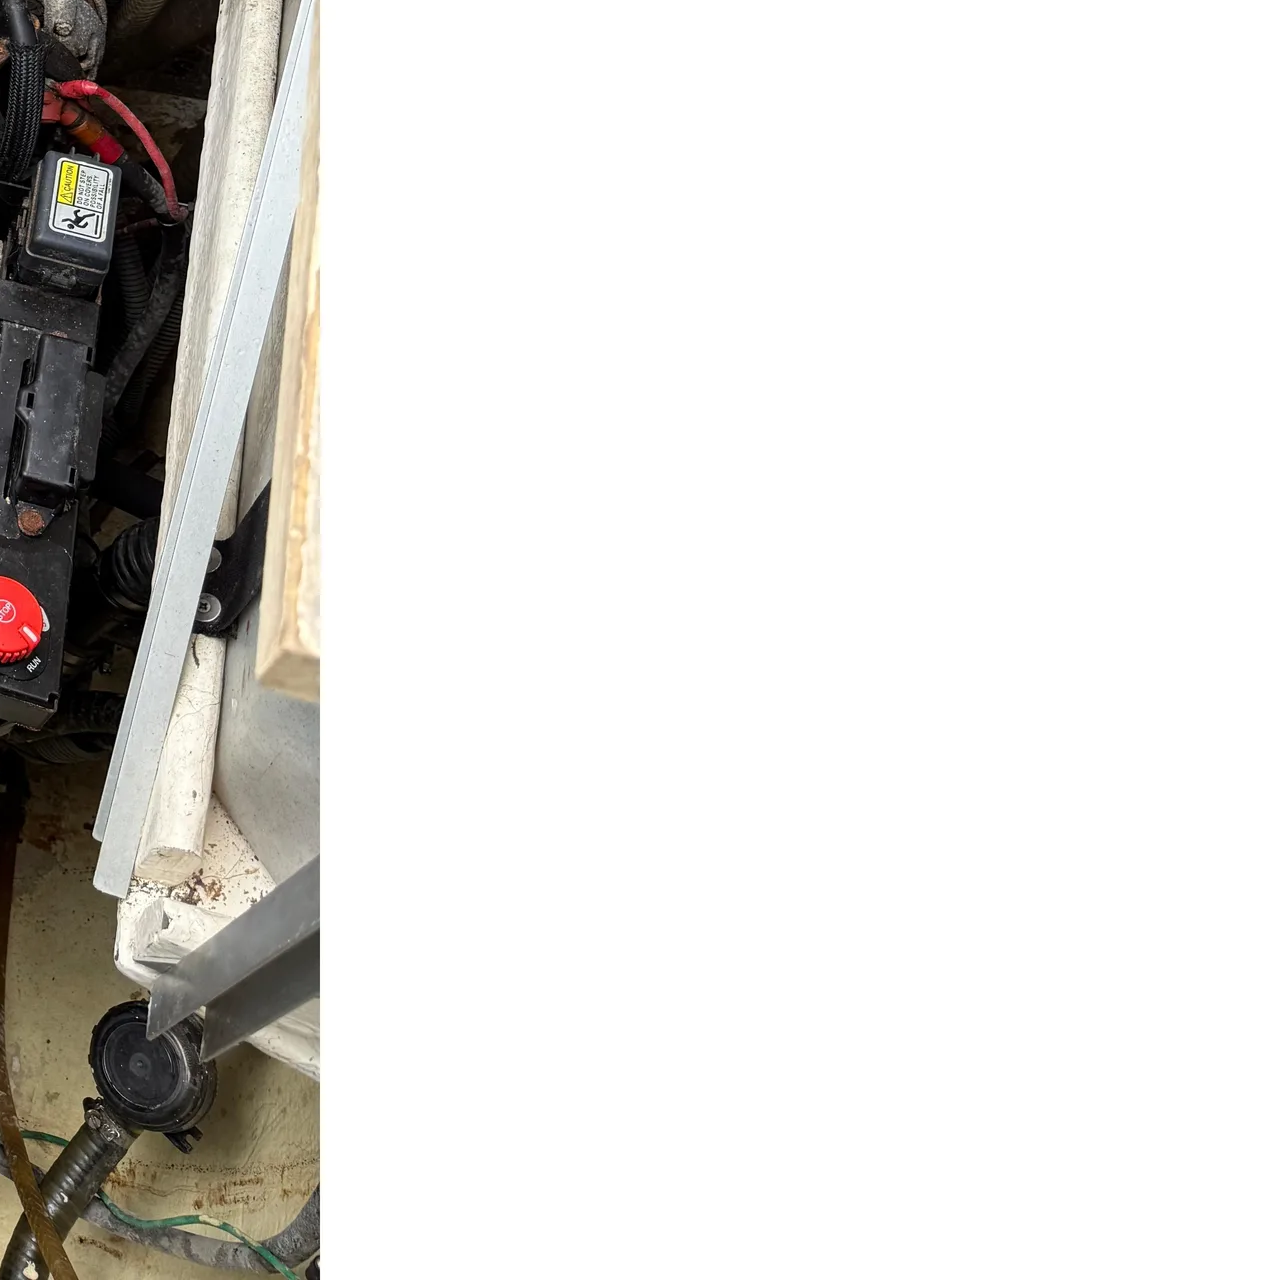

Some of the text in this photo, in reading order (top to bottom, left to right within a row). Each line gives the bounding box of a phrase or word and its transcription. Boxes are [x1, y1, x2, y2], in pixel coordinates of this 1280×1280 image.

[64, 165, 74, 191] CAUTION
[77, 196, 83, 205] DO
[83, 198, 90, 206] ON
[96, 201, 102, 210] OF
[26, 656, 42, 673] RUN
